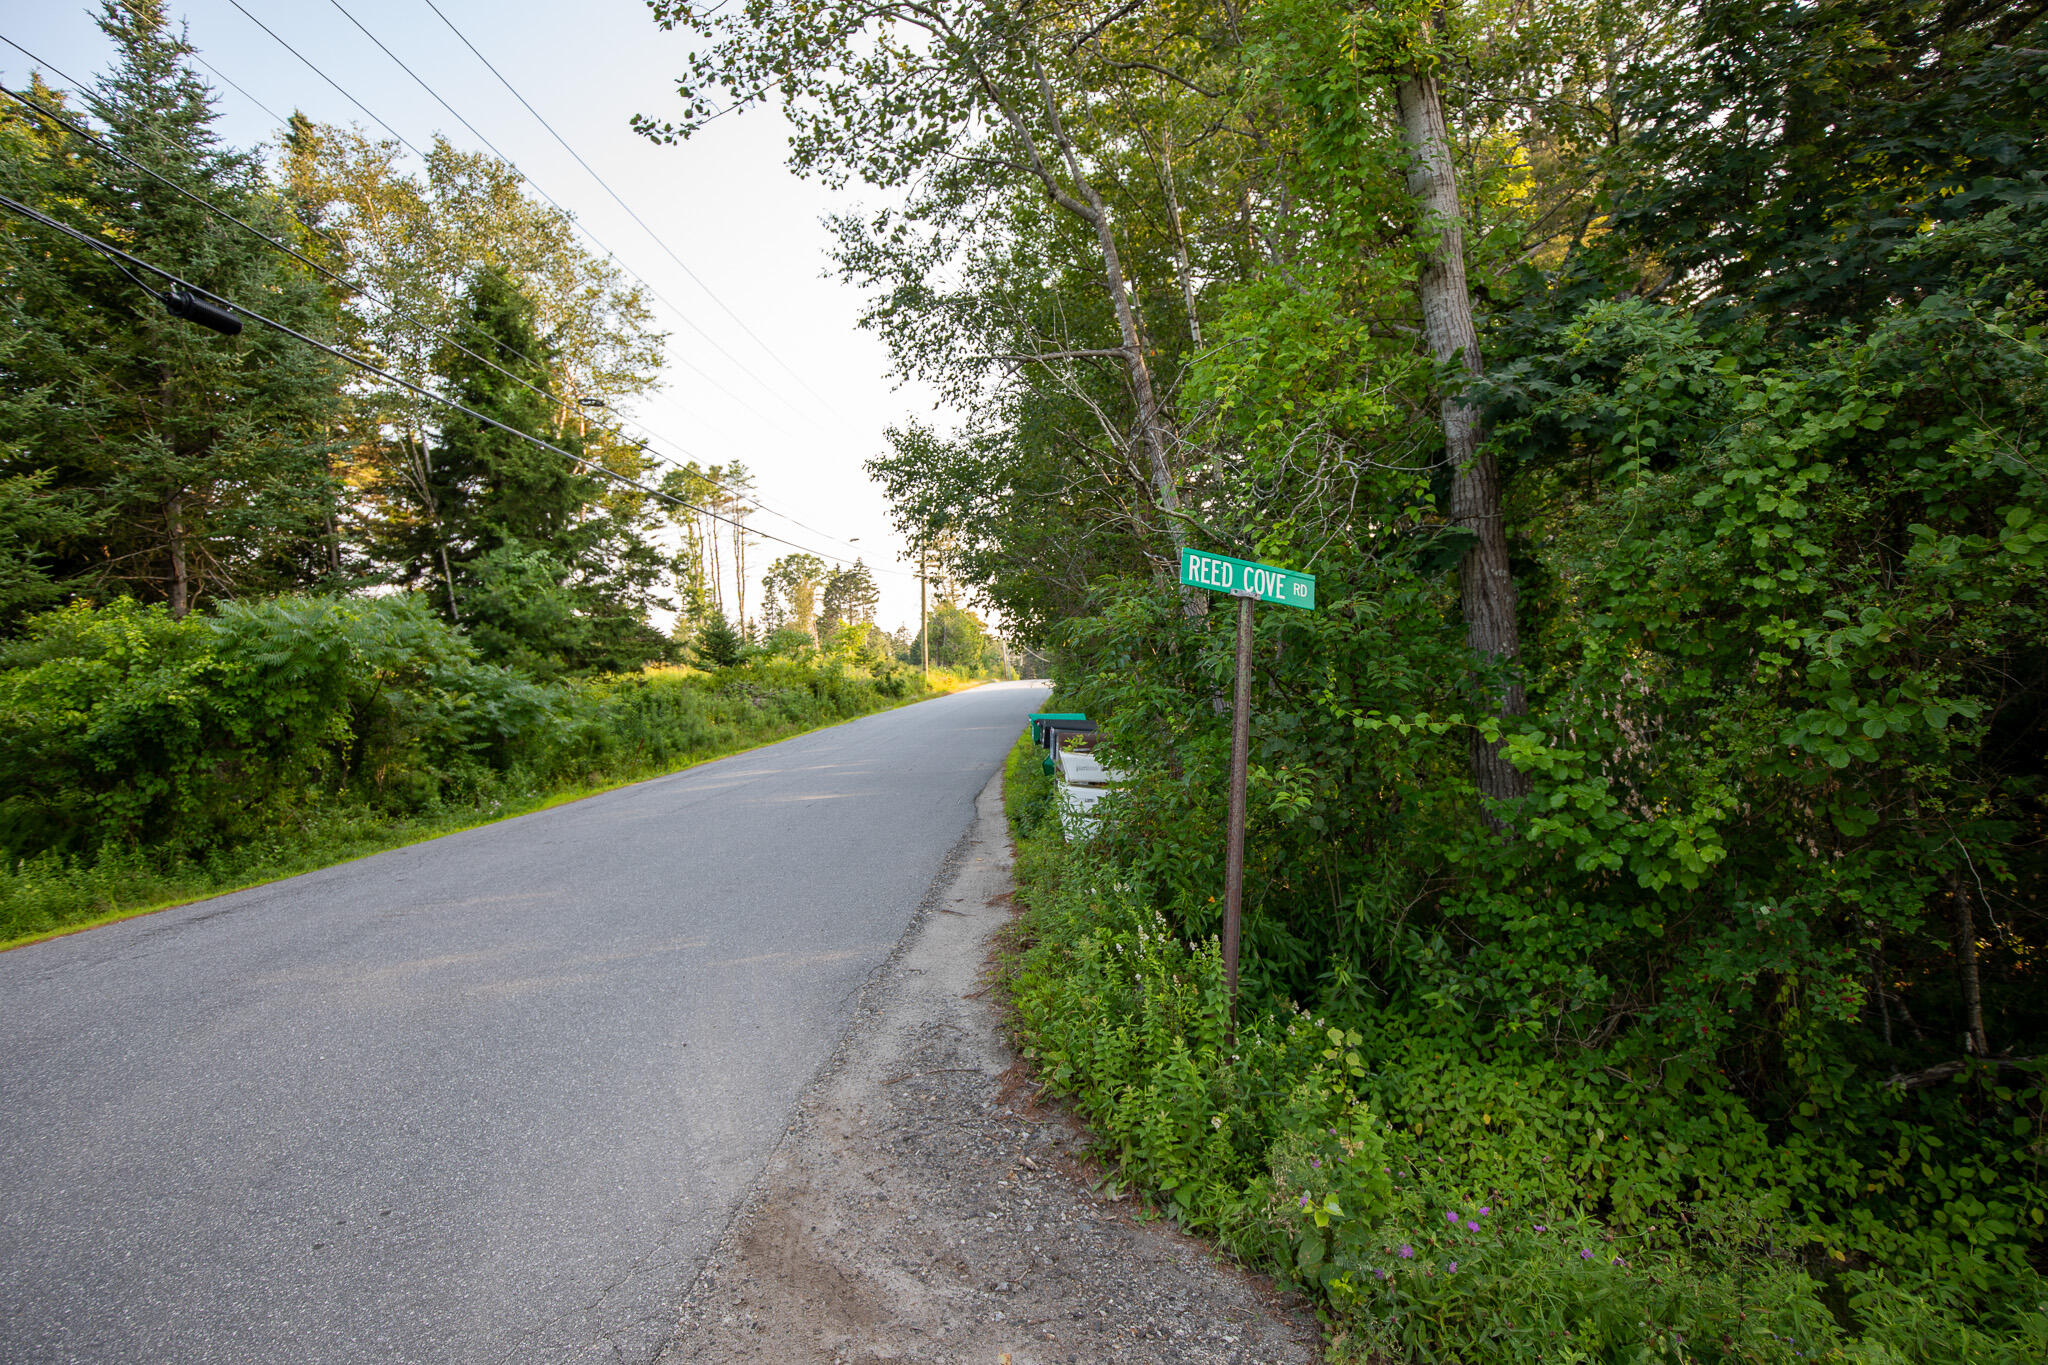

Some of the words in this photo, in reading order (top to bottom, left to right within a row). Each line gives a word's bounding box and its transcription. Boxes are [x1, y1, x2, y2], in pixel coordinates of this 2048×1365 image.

[1189, 555, 1233, 588] REED
[1244, 567, 1286, 599] COVE
[1293, 583, 1308, 597] RD
